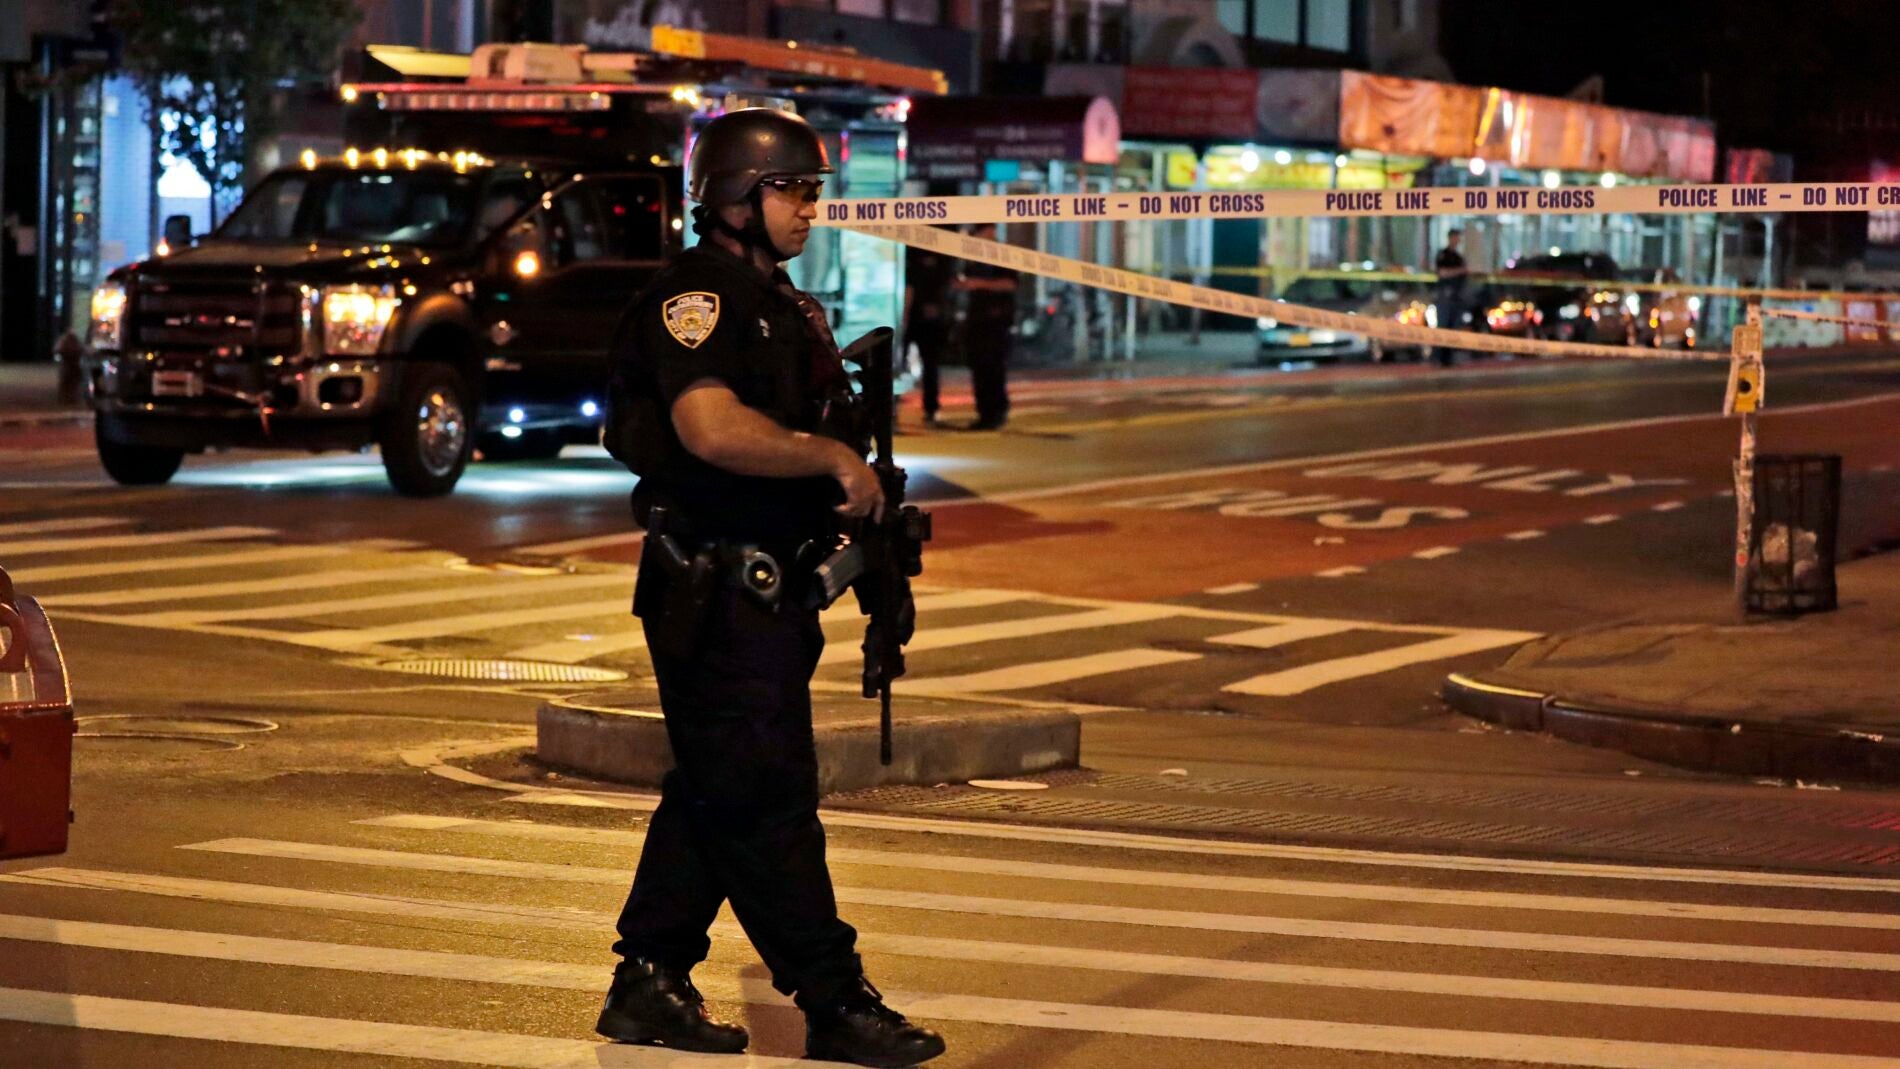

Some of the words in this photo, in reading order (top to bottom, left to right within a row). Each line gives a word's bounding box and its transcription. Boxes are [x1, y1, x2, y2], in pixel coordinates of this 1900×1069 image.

[1006, 199, 1061, 216] POLICE
[1074, 198, 1107, 215] LINE
[1140, 196, 1162, 214] DO
[1170, 195, 1202, 213] NOT
[1209, 194, 1265, 212] CROSS
[1325, 192, 1383, 211] POLICE
[1396, 191, 1430, 209] LINE
[1465, 191, 1488, 209] DO
[1496, 190, 1529, 209] NOT
[1537, 190, 1595, 208] CROSS
[1659, 188, 1718, 207] POLICE
[1732, 188, 1768, 206] LINE
[1803, 187, 1827, 206] DO
[1835, 187, 1870, 205] NOT
[828, 203, 848, 220] DO
[857, 203, 886, 220] NOT
[895, 201, 947, 220] CROSS
[1303, 461, 1688, 497] ONLY
[1100, 487, 1472, 530] BUS
